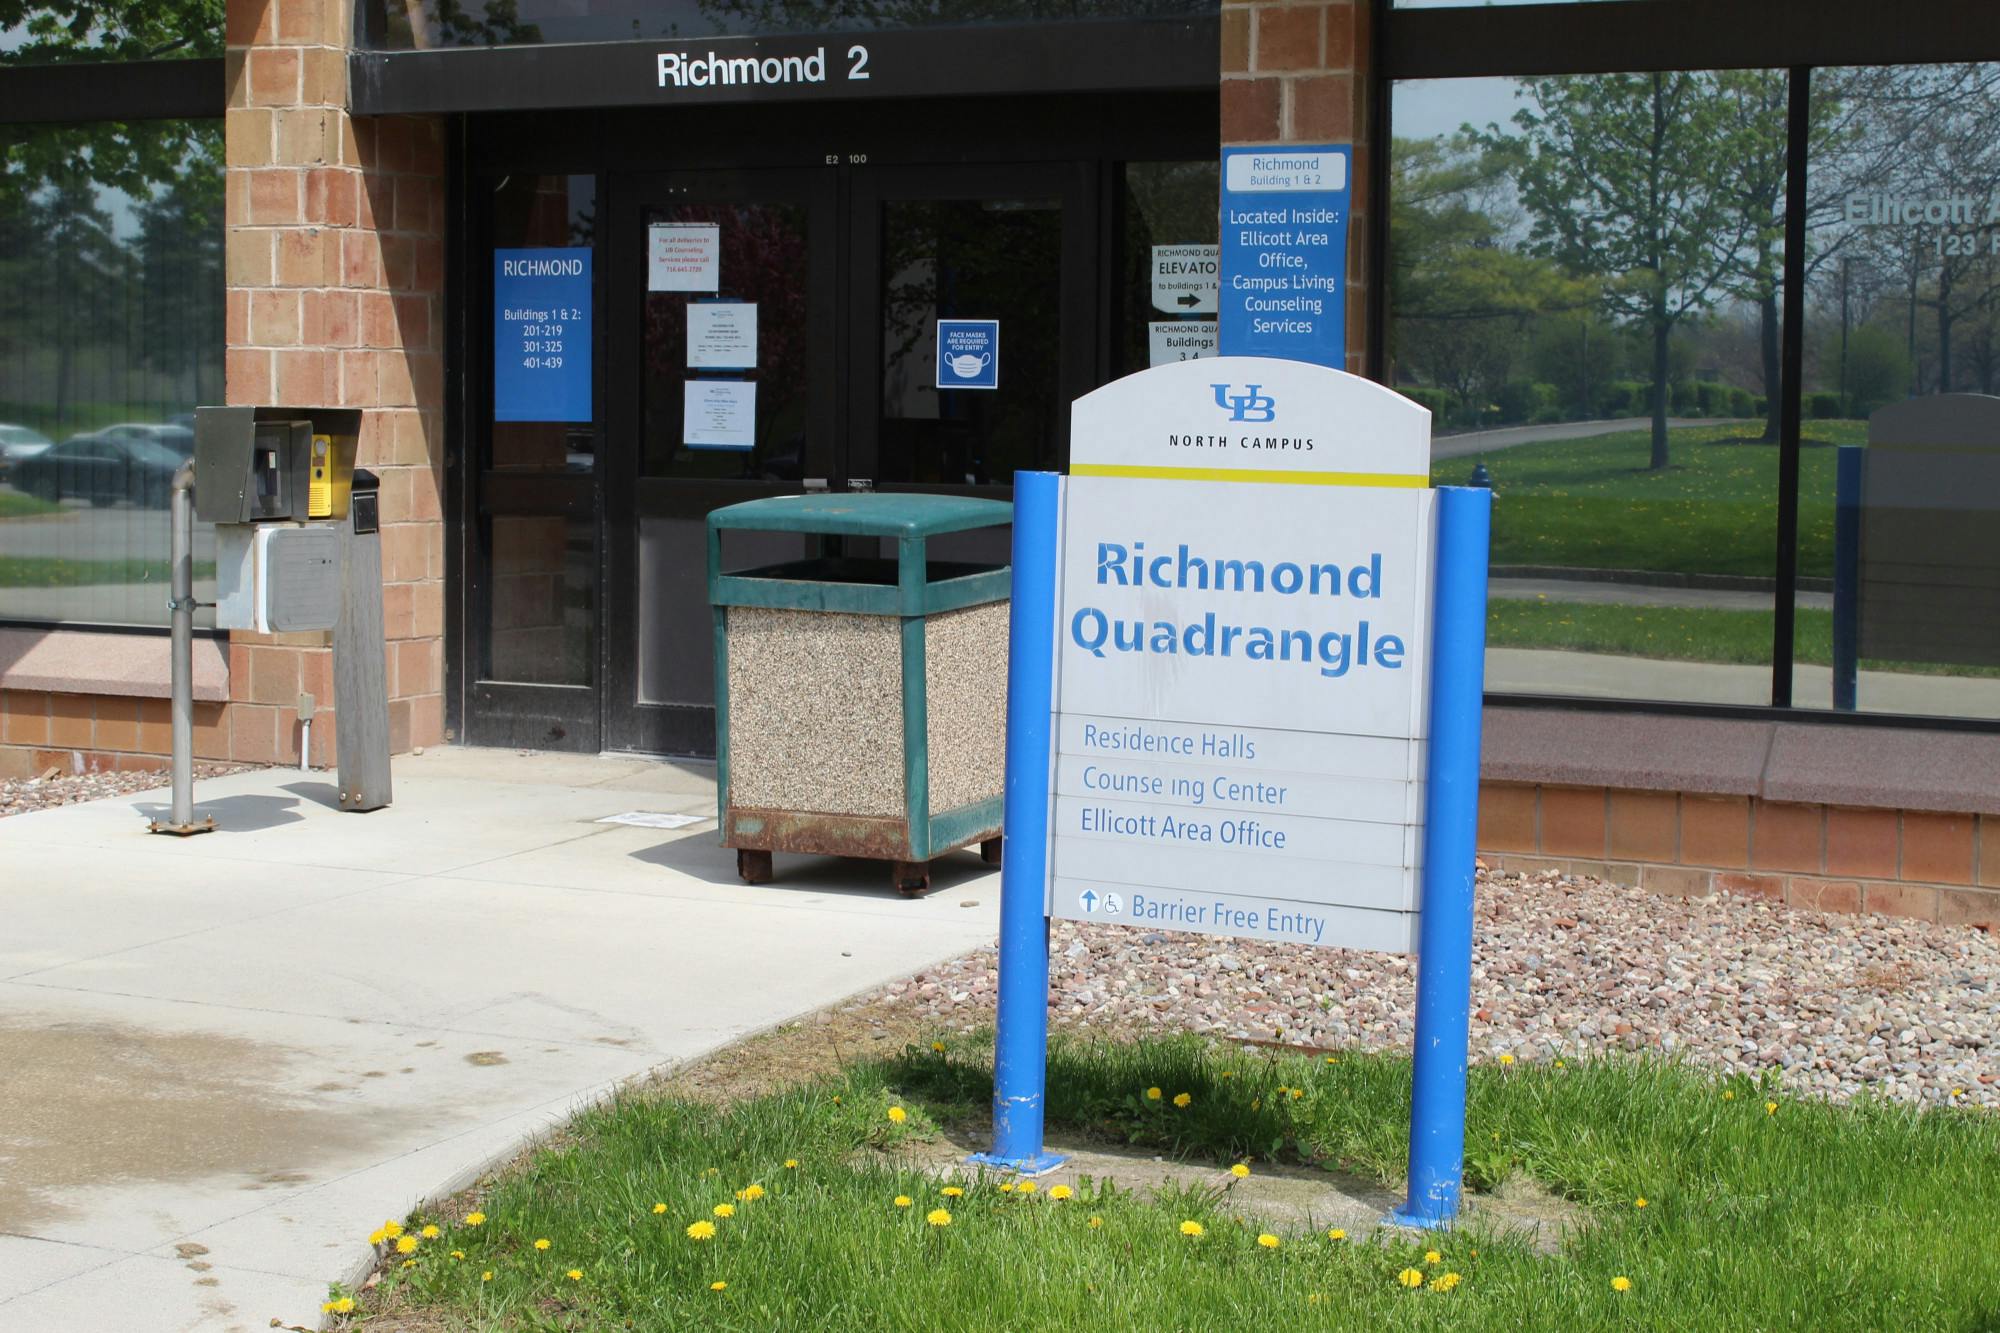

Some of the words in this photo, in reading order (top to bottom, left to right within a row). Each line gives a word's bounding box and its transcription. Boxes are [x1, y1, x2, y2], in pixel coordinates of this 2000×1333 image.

[657, 47, 826, 87] Richmond
[848, 45, 870, 80] 2
[825, 155, 839, 165] E2
[849, 154, 867, 164] 100
[1253, 157, 1319, 171] Richmond
[1250, 175, 1290, 187] Building
[1294, 175, 1299, 185] 1
[1303, 175, 1311, 185] &
[1315, 175, 1321, 184] 2
[1230, 208, 1287, 225] Located
[1292, 208, 1339, 224] Inside:
[1845, 192, 1976, 225] Ellicott
[1240, 230, 1292, 246] Ellicott
[1296, 231, 1328, 246] Area
[1933, 233, 1976, 256] 123
[1157, 248, 1201, 257] RICHMOND
[1259, 252, 1308, 270] Office,
[504, 259, 583, 276] RICHMOND
[1159, 262, 1217, 274] ELEVATO
[1158, 282, 1166, 290] to
[1168, 282, 1203, 291] buildings
[1233, 275, 1288, 293] Campus
[1293, 274, 1335, 293] Living
[1245, 296, 1322, 315] Counseling
[504, 309, 549, 323] Buildings
[551, 309, 557, 320] 1
[560, 309, 569, 320] &
[571, 308, 582, 320] 2:
[523, 325, 563, 336] 201-219
[1155, 325, 1199, 333] RICHMOND
[1253, 318, 1312, 333] Services
[523, 341, 563, 352] 301-325
[1166, 337, 1214, 349] Buildings
[523, 357, 563, 368] 401-439
[1210, 384, 1275, 422] UB
[1169, 434, 1227, 448] NORTH
[1240, 436, 1314, 451] CAMPUS
[1096, 541, 1382, 599] Richmond
[1071, 607, 1406, 678] Quadrangle
[1084, 724, 1194, 755] Residence
[1202, 732, 1256, 759] Halls
[1083, 766, 1205, 805] Counseing
[1213, 776, 1287, 805] Center
[1081, 807, 1156, 837] Ellicott
[1161, 815, 1212, 842] Area
[1220, 820, 1286, 849] Office
[1132, 895, 1206, 924] Barrier
[1214, 902, 1259, 929] Free
[1267, 907, 1325, 942] Entry
